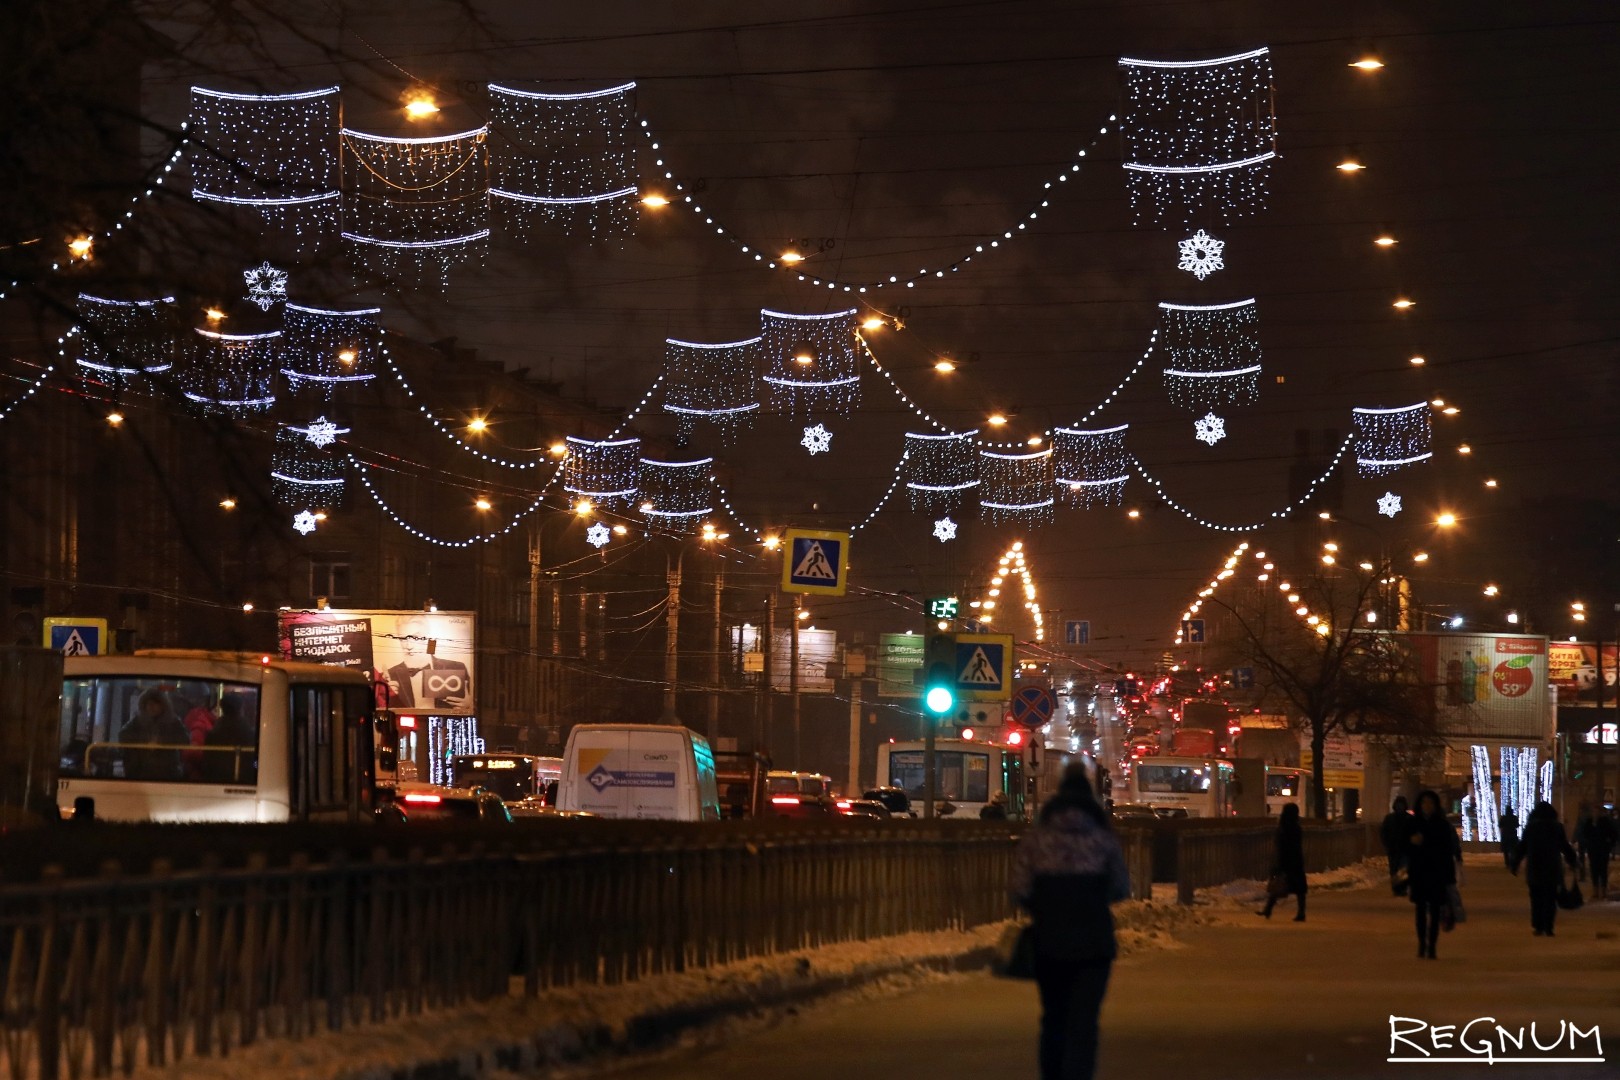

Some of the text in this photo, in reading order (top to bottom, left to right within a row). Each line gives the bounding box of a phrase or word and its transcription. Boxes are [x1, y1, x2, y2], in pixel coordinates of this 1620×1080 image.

[293, 621, 367, 637] БЕЗЛИМИТНЫЙ
[294, 634, 344, 647] ИНТЕРНЕТ
[295, 644, 351, 656] В ПОДАРОК
